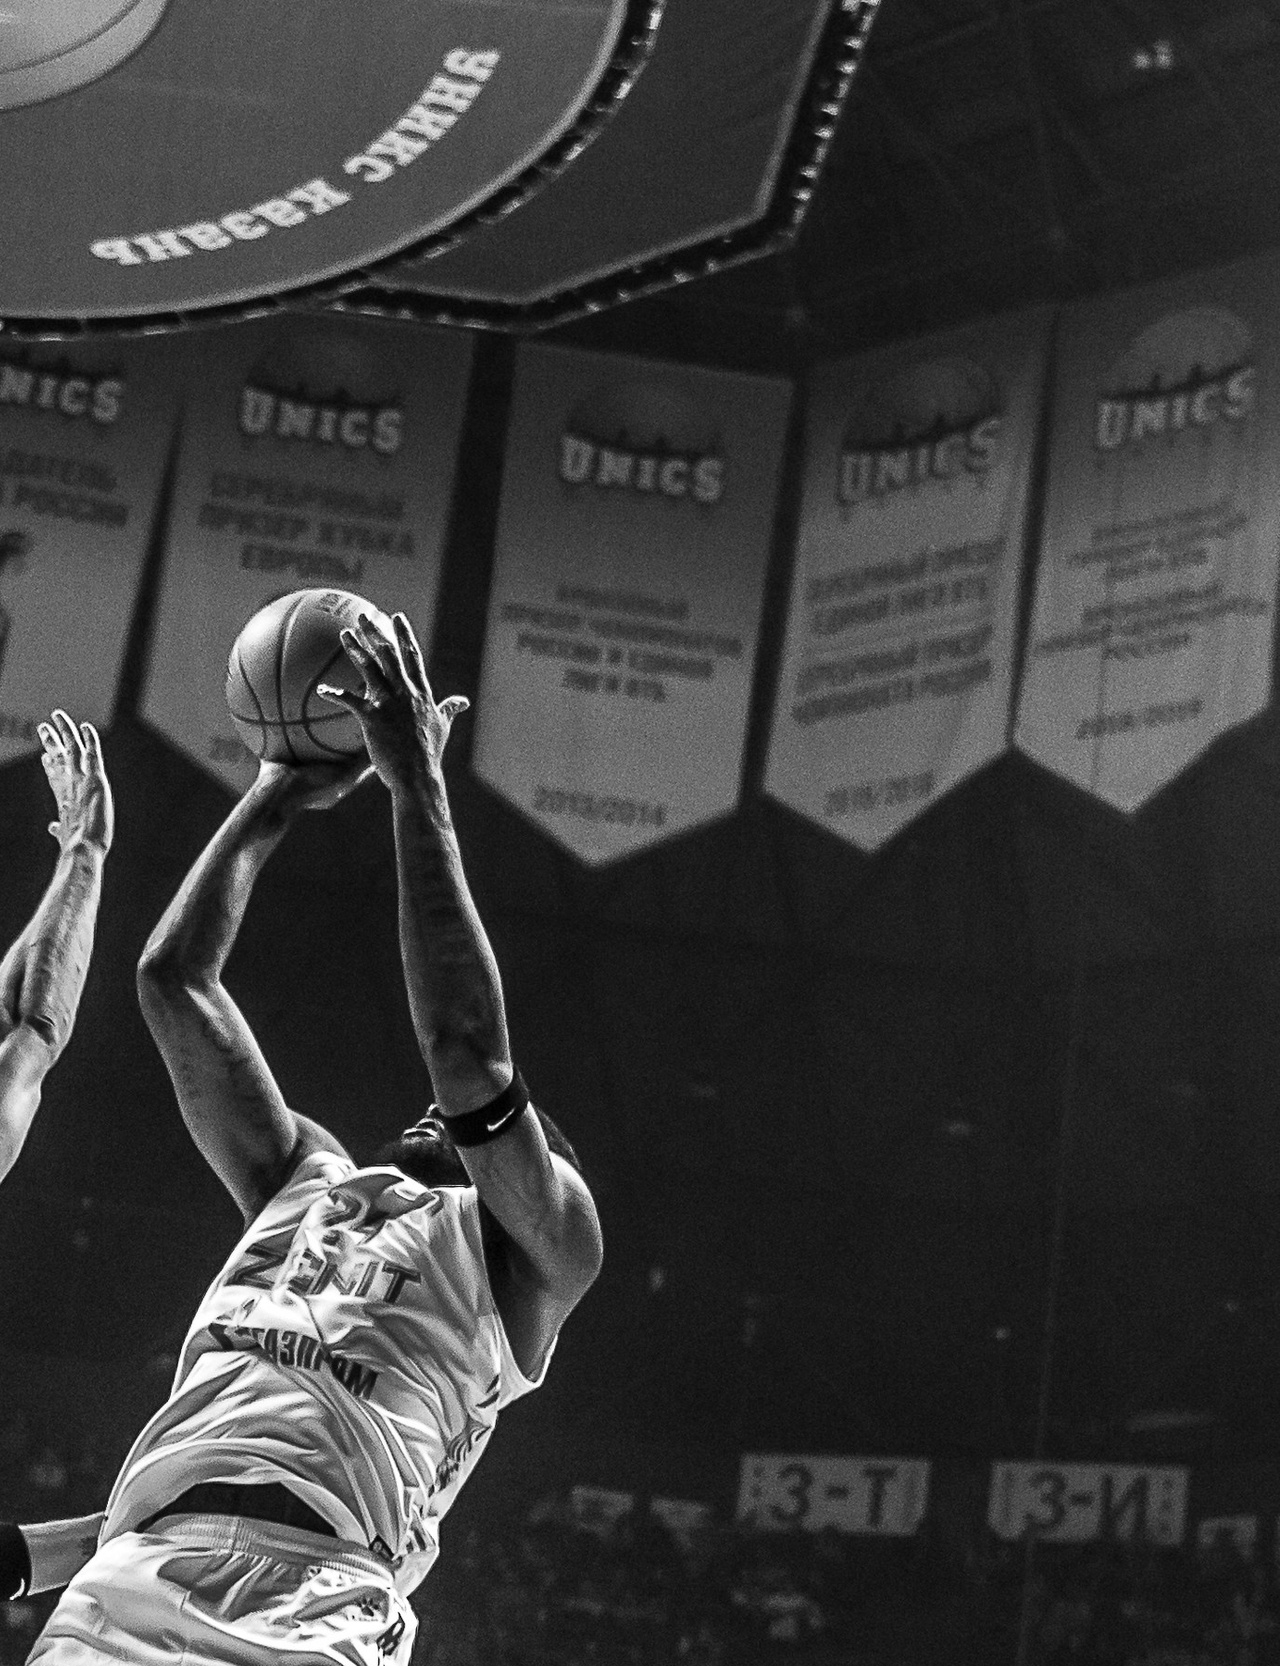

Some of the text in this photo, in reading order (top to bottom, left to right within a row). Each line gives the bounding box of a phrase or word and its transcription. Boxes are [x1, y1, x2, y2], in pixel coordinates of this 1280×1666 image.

[237, 387, 407, 453] UNICS
[1097, 367, 1256, 450] UNICS
[556, 434, 728, 505] UNICS
[837, 416, 1003, 503] UNICS
